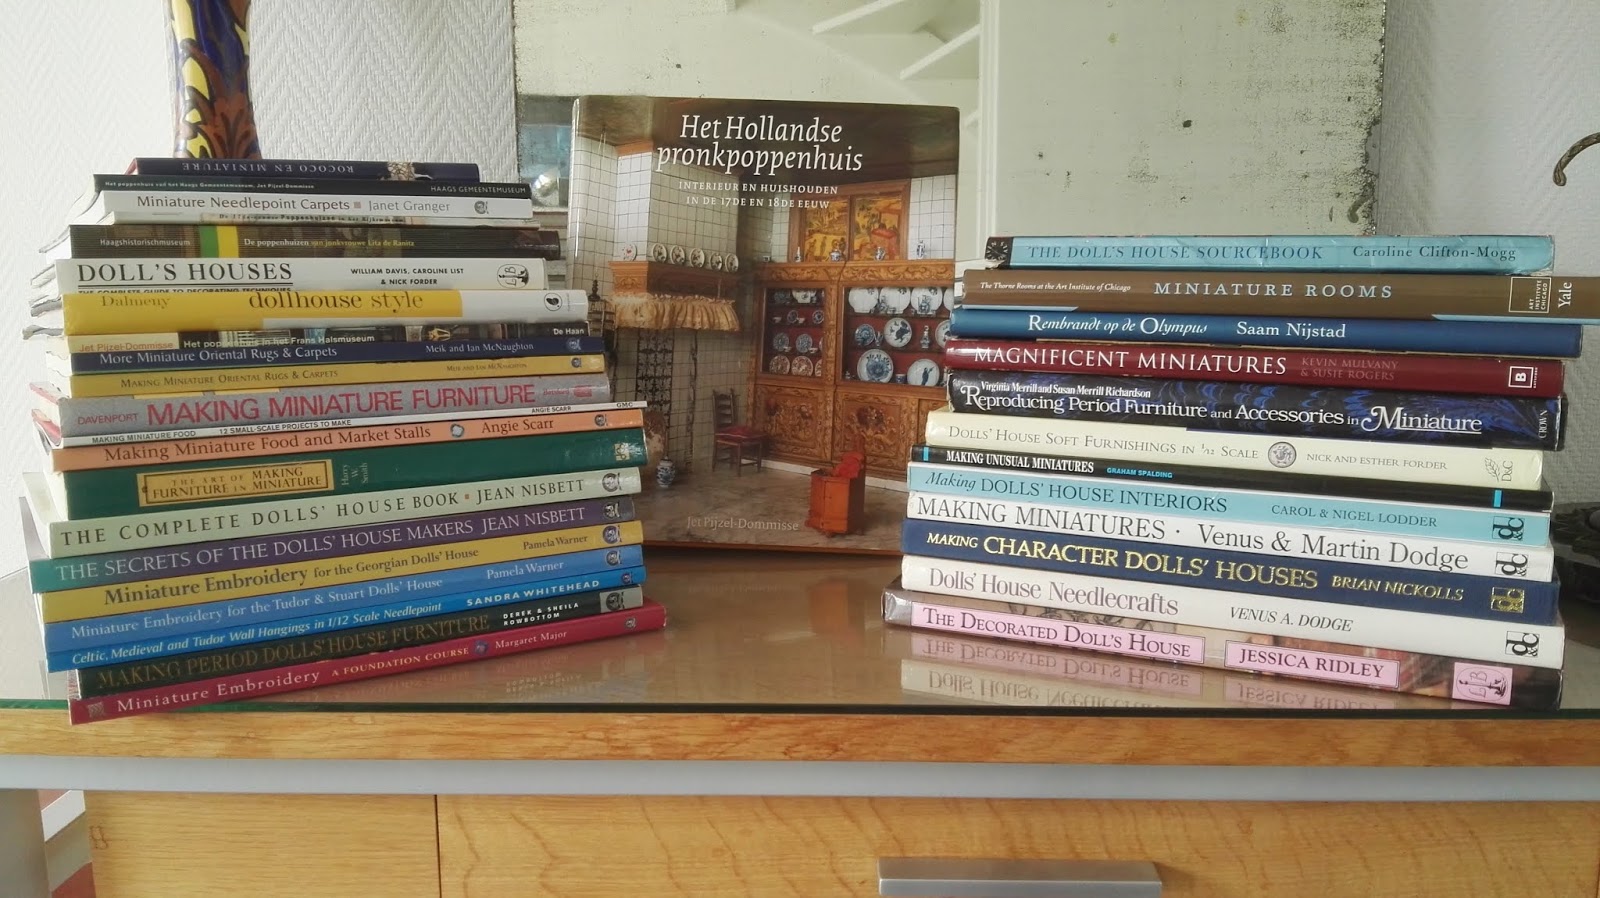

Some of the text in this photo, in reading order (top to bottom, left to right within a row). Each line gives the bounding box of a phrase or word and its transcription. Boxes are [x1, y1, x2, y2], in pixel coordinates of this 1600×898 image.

[680, 115, 843, 143] Het Hollandse
[181, 162, 354, 174] ROCOCO EN MINIATURE
[656, 142, 863, 176] pronkpoppenhuis
[430, 185, 526, 195] HAAGS GEMEENTEMUSEUM
[678, 181, 838, 195] INTERIEUR EN HUISHOUDEN
[137, 195, 450, 215] Miniature Needlepoint Carpets Janet Granger
[686, 197, 830, 209] IN DE 17DE EN 18DE EEUW
[100, 238, 191, 248] Haagshistorischmuseum
[1028, 245, 1517, 262] THE DOLL'S HOUSE SOURCEBOOK Caroline Clifton-Mogg
[78, 262, 293, 282] DOLL'S HOUSES
[385, 268, 410, 276] DAVIS,
[412, 267, 448, 275] CAROLINE
[450, 267, 464, 275] LIST
[980, 282, 992, 290] The
[993, 282, 1016, 290] Thorne
[1016, 282, 1037, 290] Rooms
[1044, 282, 1055, 290] the
[1055, 283, 1068, 291] Art
[1068, 283, 1096, 291] Institute
[1096, 283, 1105, 293] of
[1104, 283, 1132, 293] Chicago
[1154, 282, 1393, 299] MINIATURE ROOMS
[1557, 281, 1573, 309] Yale
[249, 291, 363, 309] dollhouse
[371, 292, 423, 313] style
[553, 327, 585, 336] De Haan
[973, 346, 1287, 375] MAGNIFICENT MINIATURES
[1301, 356, 1399, 370] KEVIN MULVANY
[1300, 368, 1395, 381] & SUSIE ROGERS
[980, 381, 1151, 398] Virginia Merrill and Susan Merrill Richardson
[77, 384, 536, 426] DAVENPORT MAKING MINIATURE FURNITURE
[960, 385, 1482, 433] Reproducing Period Furniture and Accessories in Miniature
[92, 435, 125, 443] MAKING
[127, 432, 170, 442] MINIATURE
[171, 430, 197, 439] FOOD
[229, 424, 280, 435] SMALL-SCALE
[281, 421, 319, 431] PROJECTS
[332, 419, 352, 427] MAKE
[531, 406, 551, 414] ANGIE
[552, 405, 572, 413] SCARR
[1537, 409, 1548, 439] CROWN
[946, 450, 1173, 479] MAKING UNUSUAL MINIATURES GRAHAM SPALDING
[171, 466, 304, 486] THE ART OF MAKING
[153, 476, 322, 499] FURNITURE IN MINIATURE
[687, 516, 799, 532] Jet Pijzel-Dommisse
[104, 534, 588, 606] Miniature Embroidery for the Georgian Dolls' House Pamela Warner
[929, 567, 1354, 632] Dolls' House Needlecrafts VENUS A. DODGE
[503, 602, 580, 620] DEREK & SHEILA
[503, 612, 561, 626] ROWBOTTOM
[72, 579, 600, 665] Celtic, Medieval and Tudor Wall Hangings in 1/12 Scale Needlepoint SANDRA WHITEHEAD
[923, 607, 1386, 680] THE DECORATED DOLL'S HOUSE JESSICA RIDLEY
[117, 630, 568, 712] Miniature Embroidery A FOUNDATION COURSE Margaret Major
